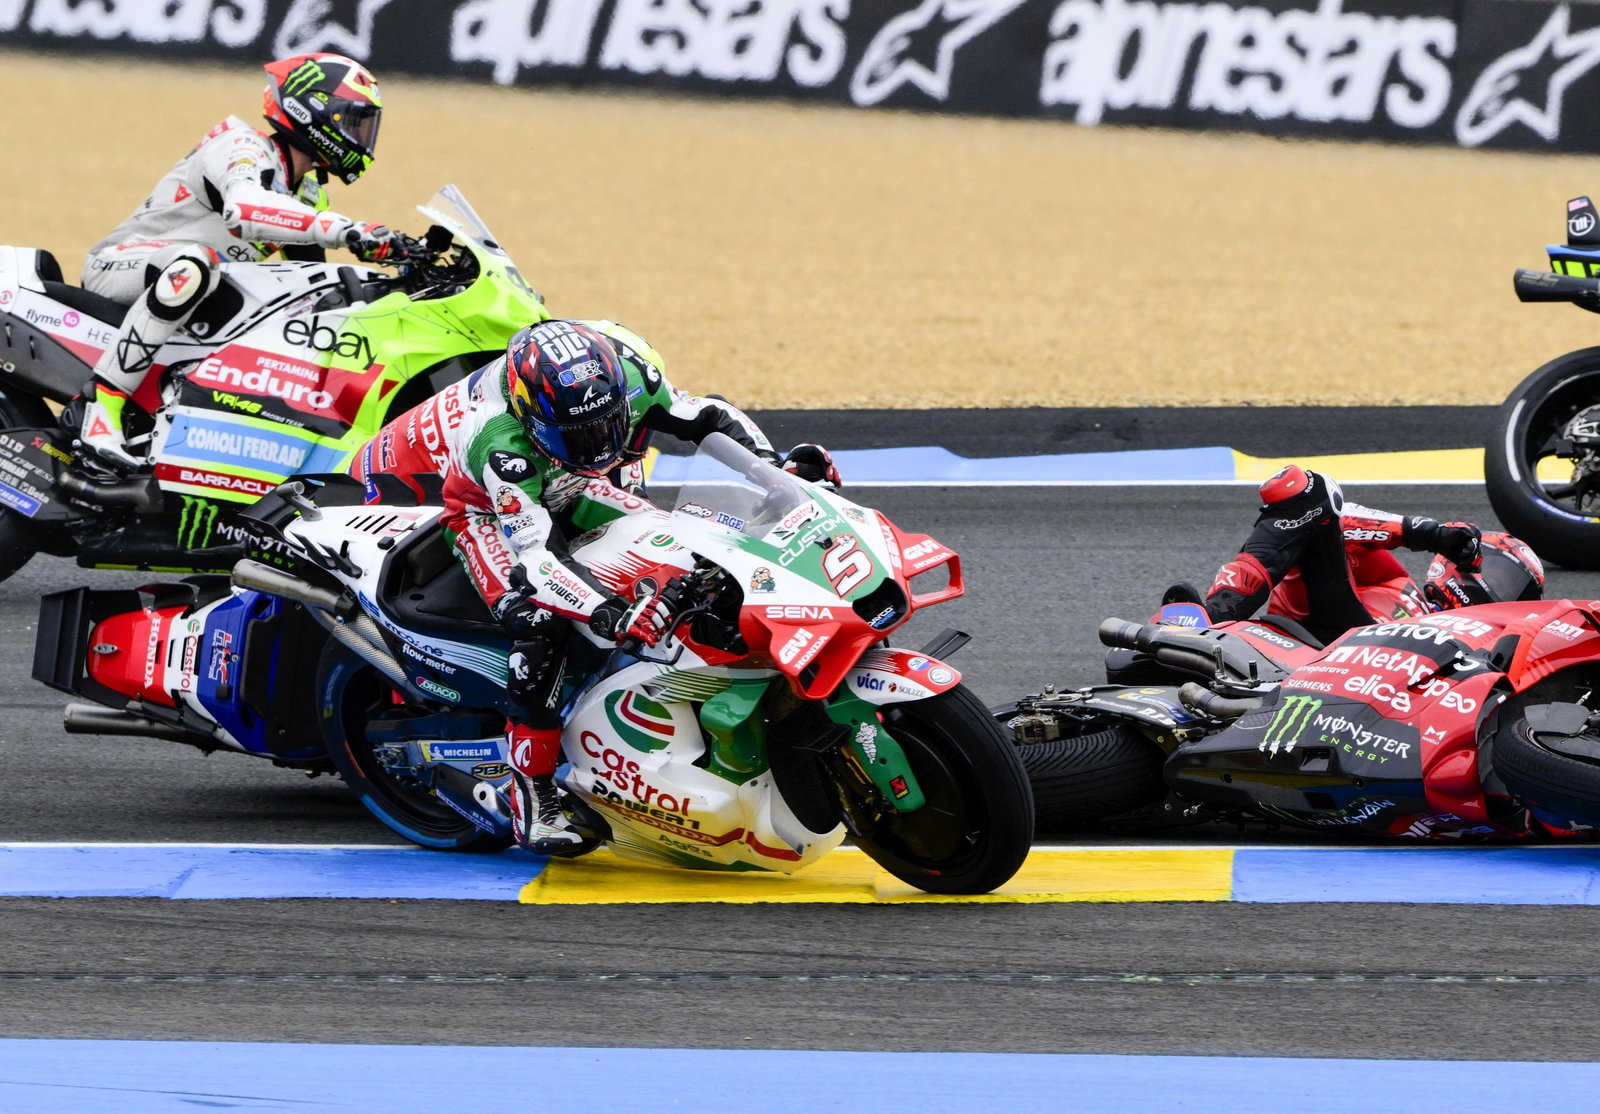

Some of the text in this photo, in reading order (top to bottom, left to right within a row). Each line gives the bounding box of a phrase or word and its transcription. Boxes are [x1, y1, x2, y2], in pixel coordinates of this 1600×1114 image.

[286, 100, 308, 121] SHOEI
[249, 210, 303, 228] Enduro
[227, 245, 251, 262] eb
[283, 315, 378, 371] ebay
[256, 356, 320, 383] PERTAMINA
[195, 357, 333, 409] Enduro
[568, 392, 613, 416] SHARK
[260, 410, 305, 429] RACING TEAM
[186, 426, 306, 468] COMOLI FERRARI
[180, 470, 277, 495] BARRACU
[716, 512, 745, 531] IRGE
[1273, 506, 1323, 530] alpinestars
[477, 522, 514, 578] Castro
[778, 514, 846, 567] CUSTOM
[902, 538, 941, 560] GIVI
[457, 531, 489, 592] HONDA
[822, 533, 873, 600] 5
[912, 552, 952, 569] HONDA
[552, 569, 592, 600] Castrol
[1446, 578, 1471, 604] Lenovo
[765, 606, 834, 620] SENA
[867, 606, 893, 627] DAYCO
[1176, 615, 1200, 627] TIM
[1244, 626, 1296, 649] Lenovo
[1419, 614, 1494, 639] GIVI
[1541, 619, 1586, 639] CATI
[144, 617, 162, 690] HONDA
[778, 628, 815, 665] GIVI
[793, 635, 830, 670] HONDA
[180, 635, 198, 694] Castrol
[402, 643, 457, 675] flow-meter
[420, 680, 458, 700] DRACO
[856, 673, 886, 691] viar
[898, 685, 926, 698] SOLIZE
[1286, 678, 1334, 692] SIEMENS
[1343, 674, 1412, 713] elica
[443, 748, 492, 757] MICHELIN
[1319, 734, 1389, 764] ENERGY
[1421, 736, 1440, 746] MARELLI
